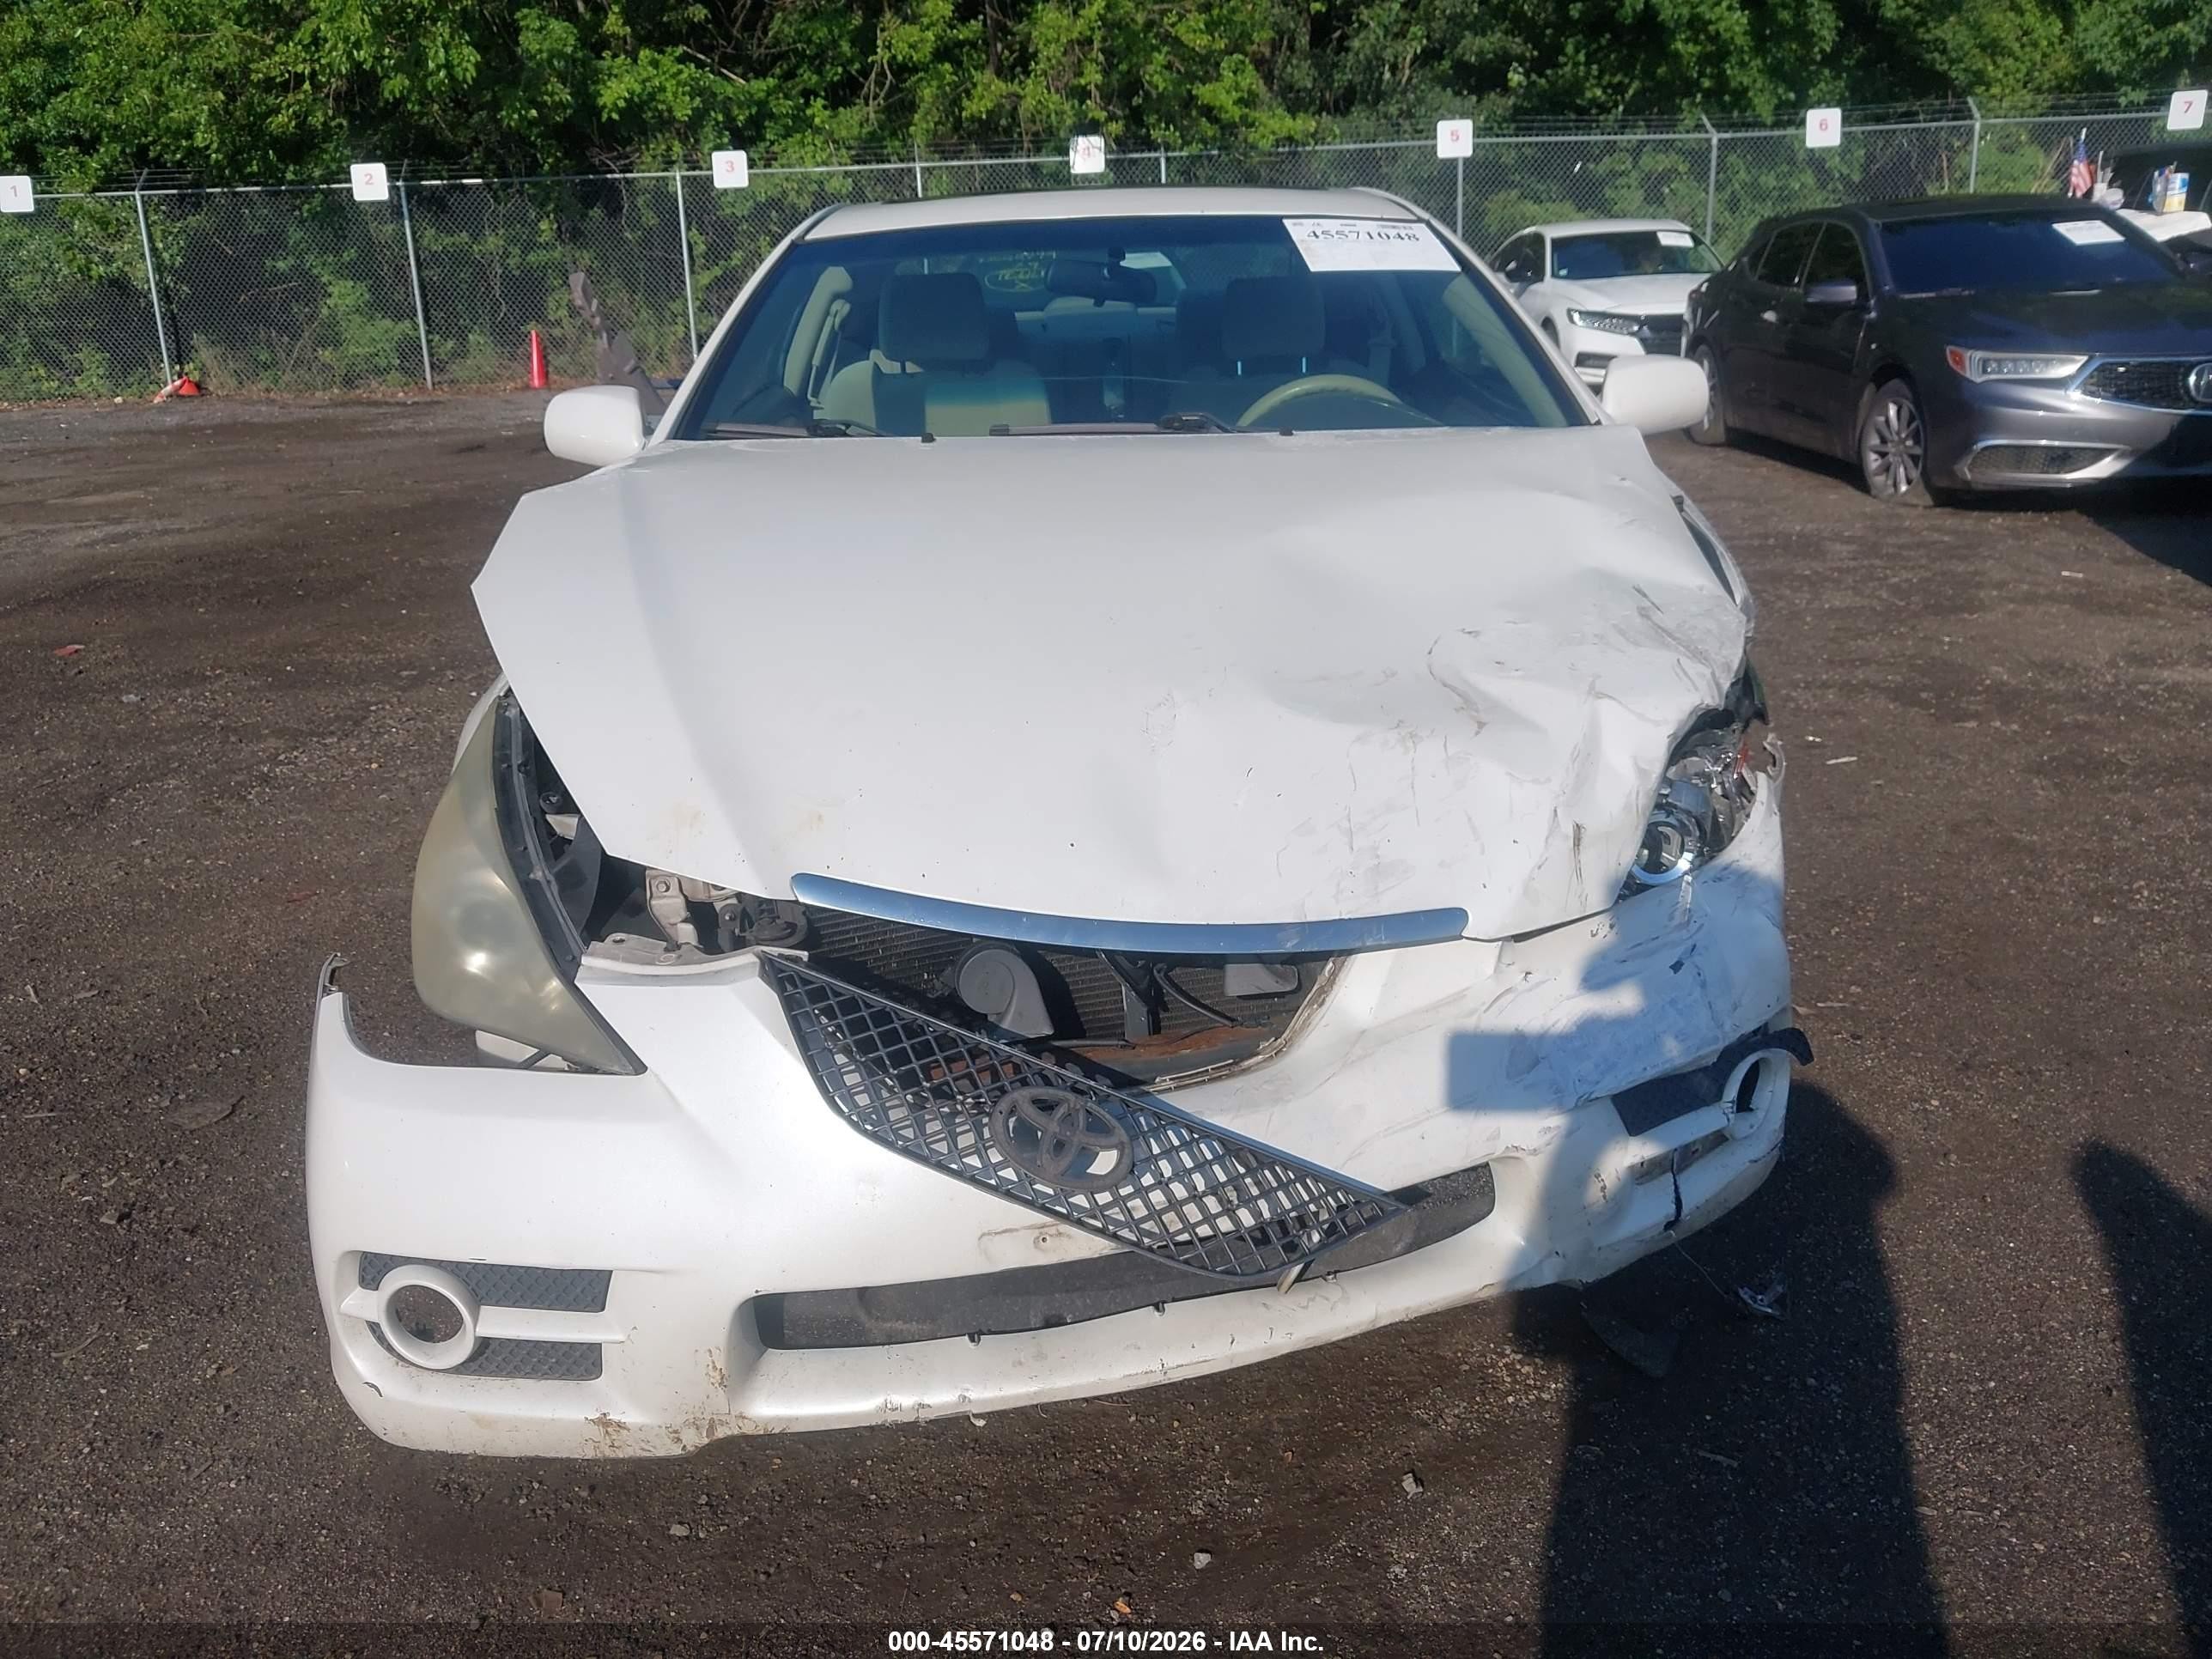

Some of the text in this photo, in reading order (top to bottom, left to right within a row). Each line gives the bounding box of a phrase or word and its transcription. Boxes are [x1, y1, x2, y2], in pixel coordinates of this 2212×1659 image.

[2184, 100, 2193, 113] 7
[1820, 118, 1828, 131] 6
[1450, 130, 1460, 142] 5
[726, 161, 735, 173] 3
[363, 173, 374, 185] 2
[9, 185, 18, 198] 1
[1306, 229, 1420, 242] 45571048
